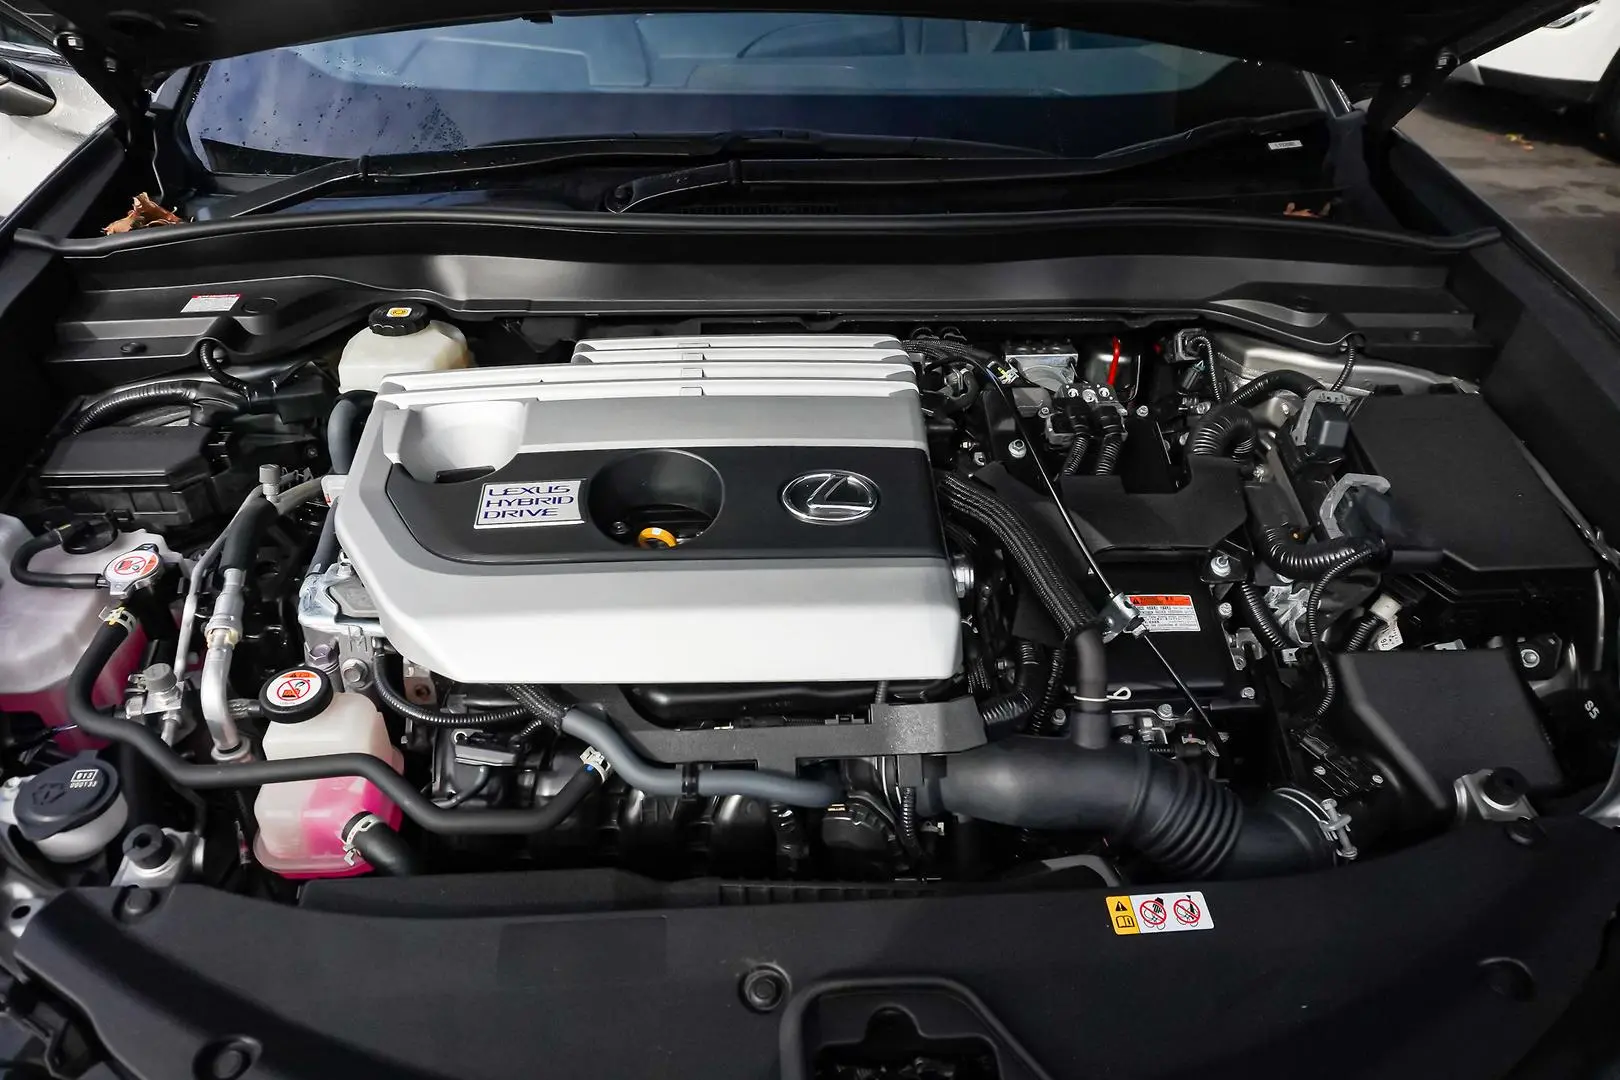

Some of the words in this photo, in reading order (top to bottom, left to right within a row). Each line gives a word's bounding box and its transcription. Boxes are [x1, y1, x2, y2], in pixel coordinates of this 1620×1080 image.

[489, 485, 571, 496] LEXUS
[486, 496, 575, 508] HYBRID
[483, 508, 560, 519] DRIVE
